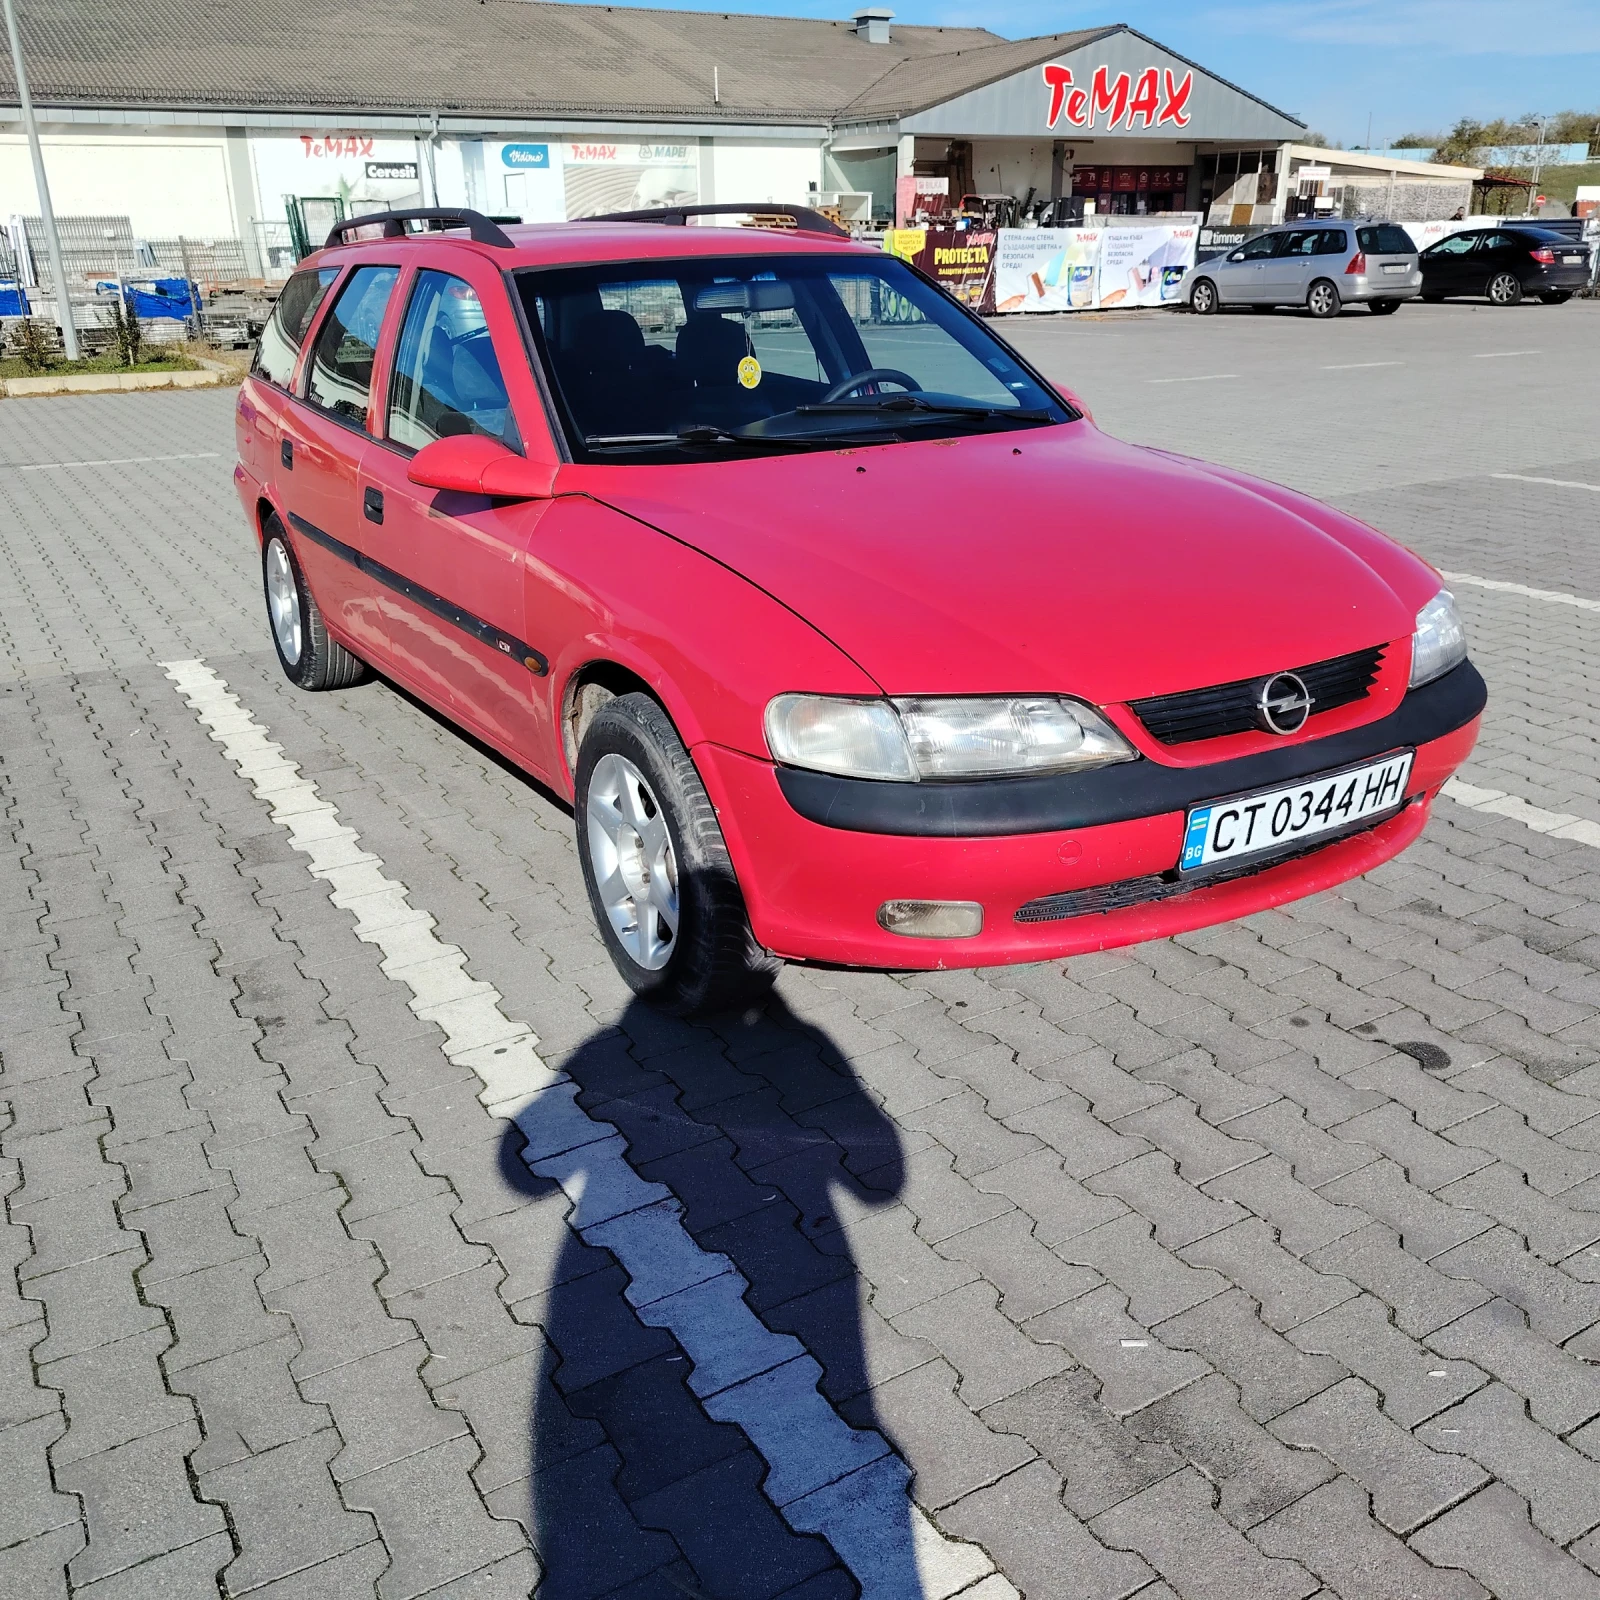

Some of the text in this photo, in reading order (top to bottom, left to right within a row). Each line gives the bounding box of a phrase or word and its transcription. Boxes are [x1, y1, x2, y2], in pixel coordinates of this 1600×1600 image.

[1043, 64, 1193, 132] TeMAX
[299, 135, 375, 159] TeMAX
[571, 144, 617, 160] TeMAX
[654, 146, 687, 158] MAPEI
[367, 164, 416, 179] Ceresit
[1076, 233, 1098, 243] TeMAX
[1173, 229, 1194, 240] TeMAX
[1213, 232, 1245, 244] timmer
[934, 246, 989, 265] PROTECTA
[1271, 777, 1358, 837] 0344
[1185, 845, 1202, 861] BG
